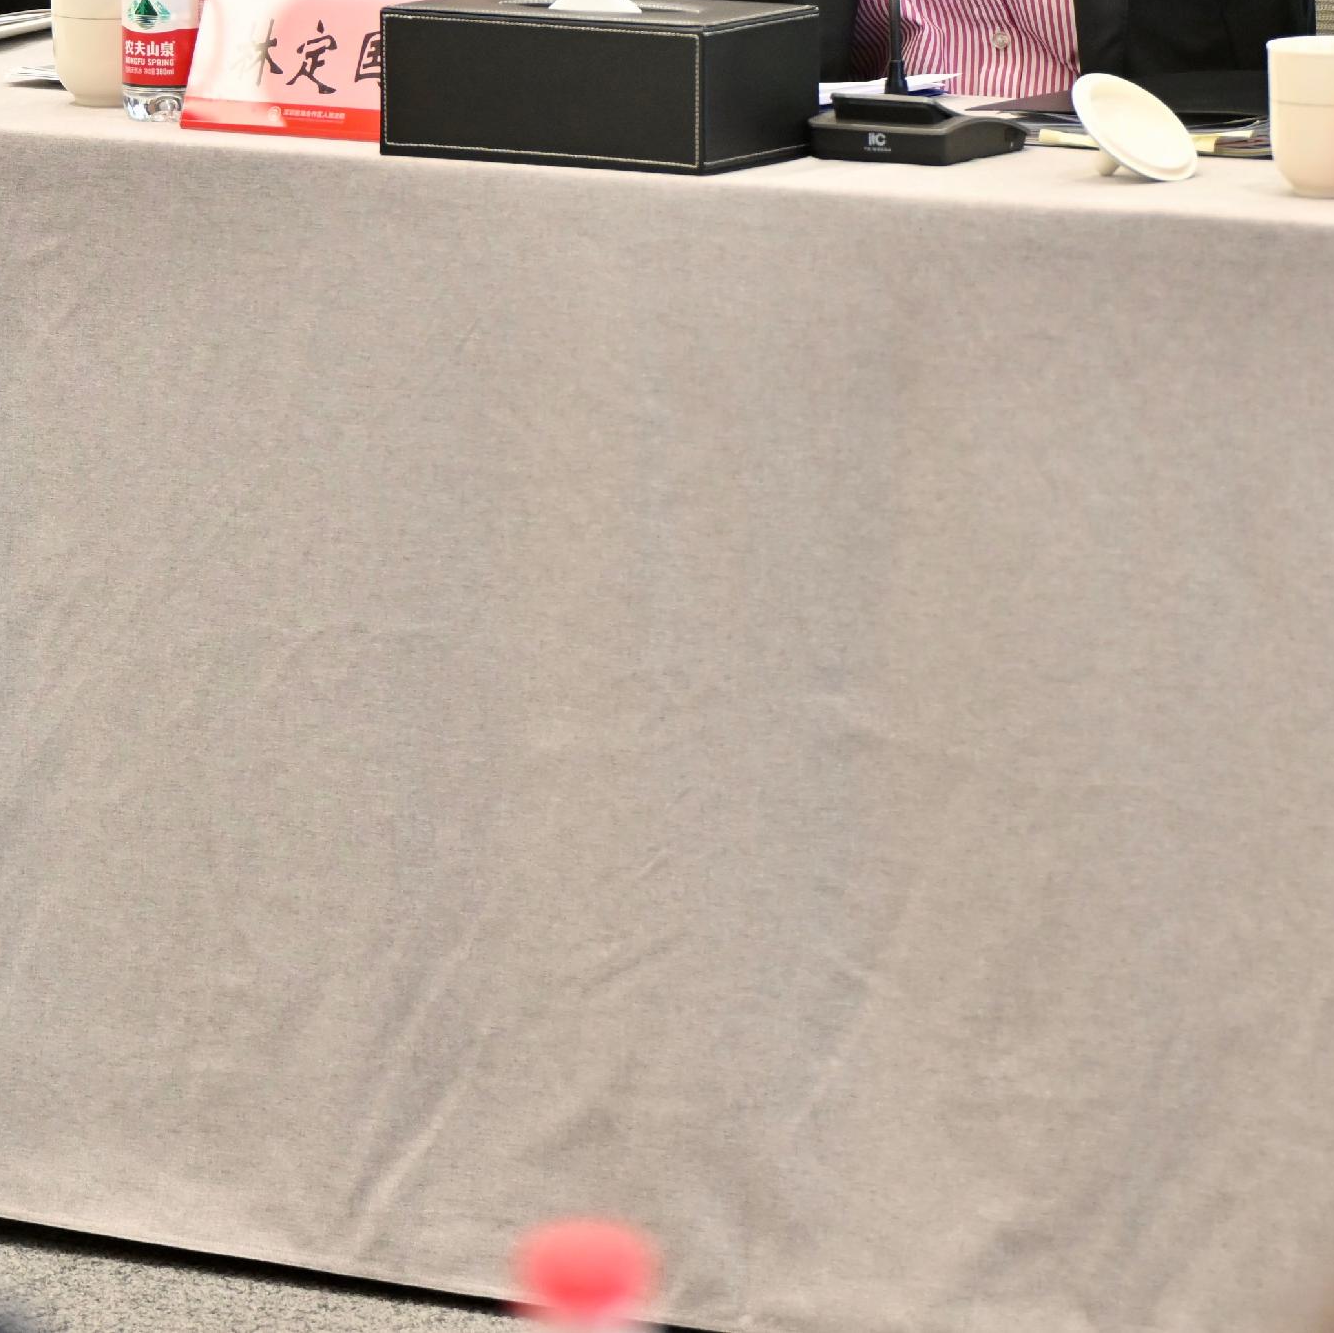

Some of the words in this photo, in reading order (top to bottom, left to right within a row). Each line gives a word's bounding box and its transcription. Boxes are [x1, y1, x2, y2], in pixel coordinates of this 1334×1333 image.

[125, 40, 174, 57] 农夫山泉
[147, 58, 174, 67] SPRING
